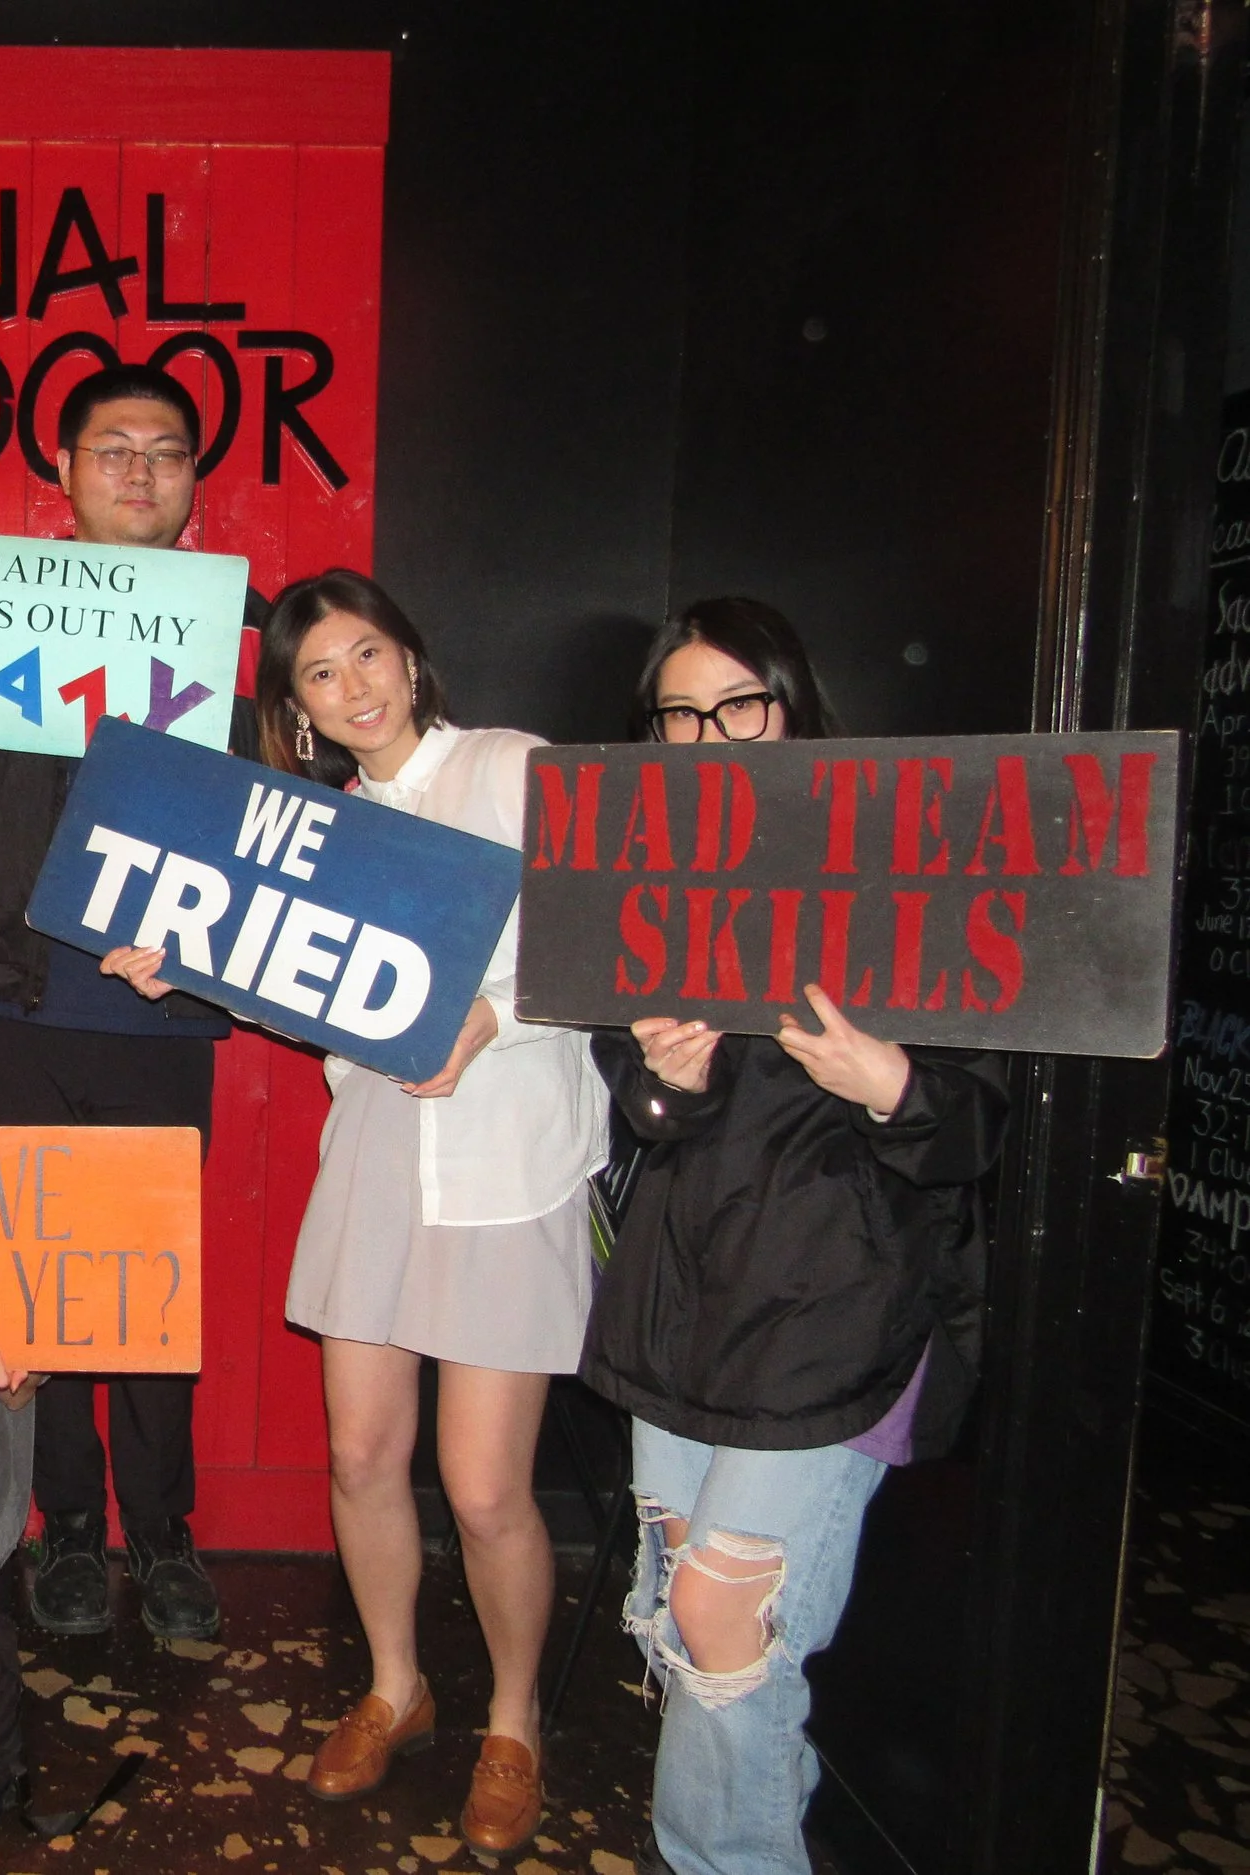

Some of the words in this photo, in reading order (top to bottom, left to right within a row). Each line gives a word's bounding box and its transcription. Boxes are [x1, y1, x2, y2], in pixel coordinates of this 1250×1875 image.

[26, 602, 115, 639] OUT
[128, 612, 198, 647] MY
[234, 783, 337, 882] WE
[531, 760, 757, 873] MAD
[812, 753, 1157, 877] TEAM
[81, 824, 432, 1040] TRIED
[614, 884, 1028, 1014] SKILLS
[11, 1250, 181, 1347] YET?
